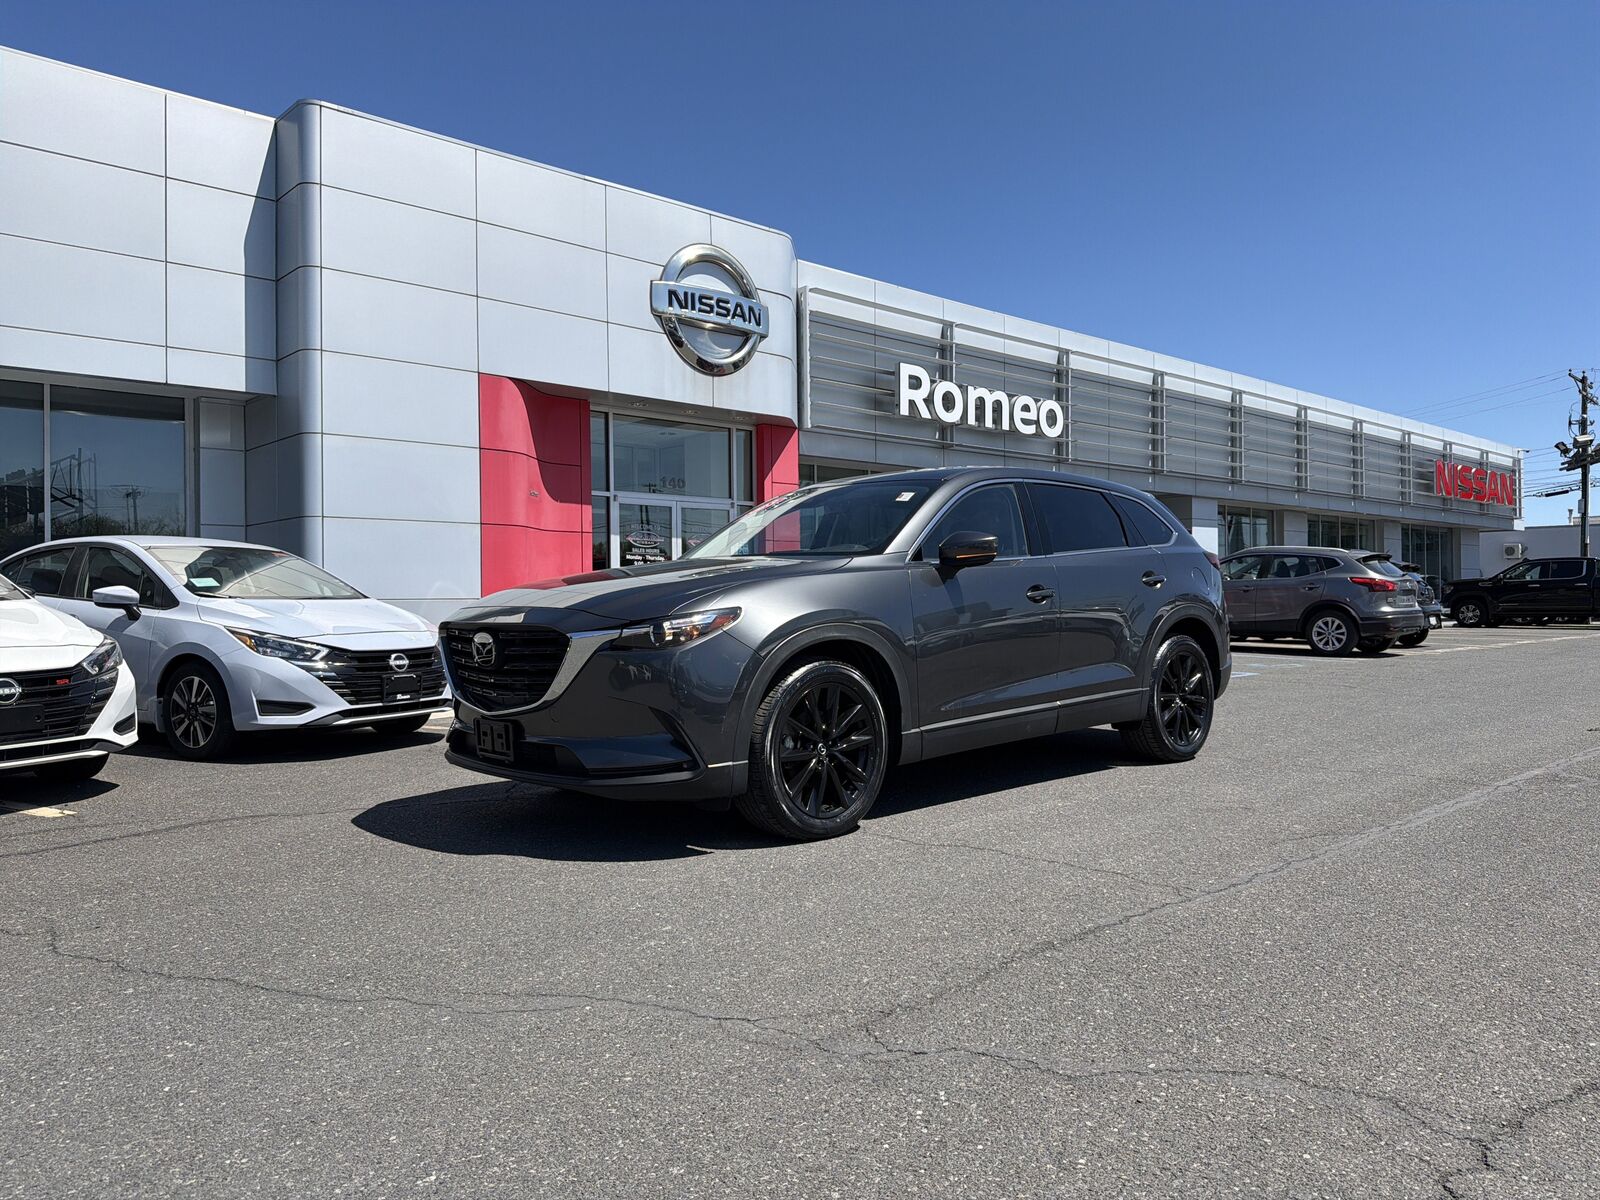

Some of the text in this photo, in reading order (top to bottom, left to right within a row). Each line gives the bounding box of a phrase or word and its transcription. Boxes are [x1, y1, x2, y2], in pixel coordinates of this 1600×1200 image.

[668, 289, 762, 327] NISSAN
[899, 362, 1064, 438] Romeo
[660, 476, 686, 489] 140
[1435, 459, 1515, 506] NISSAN
